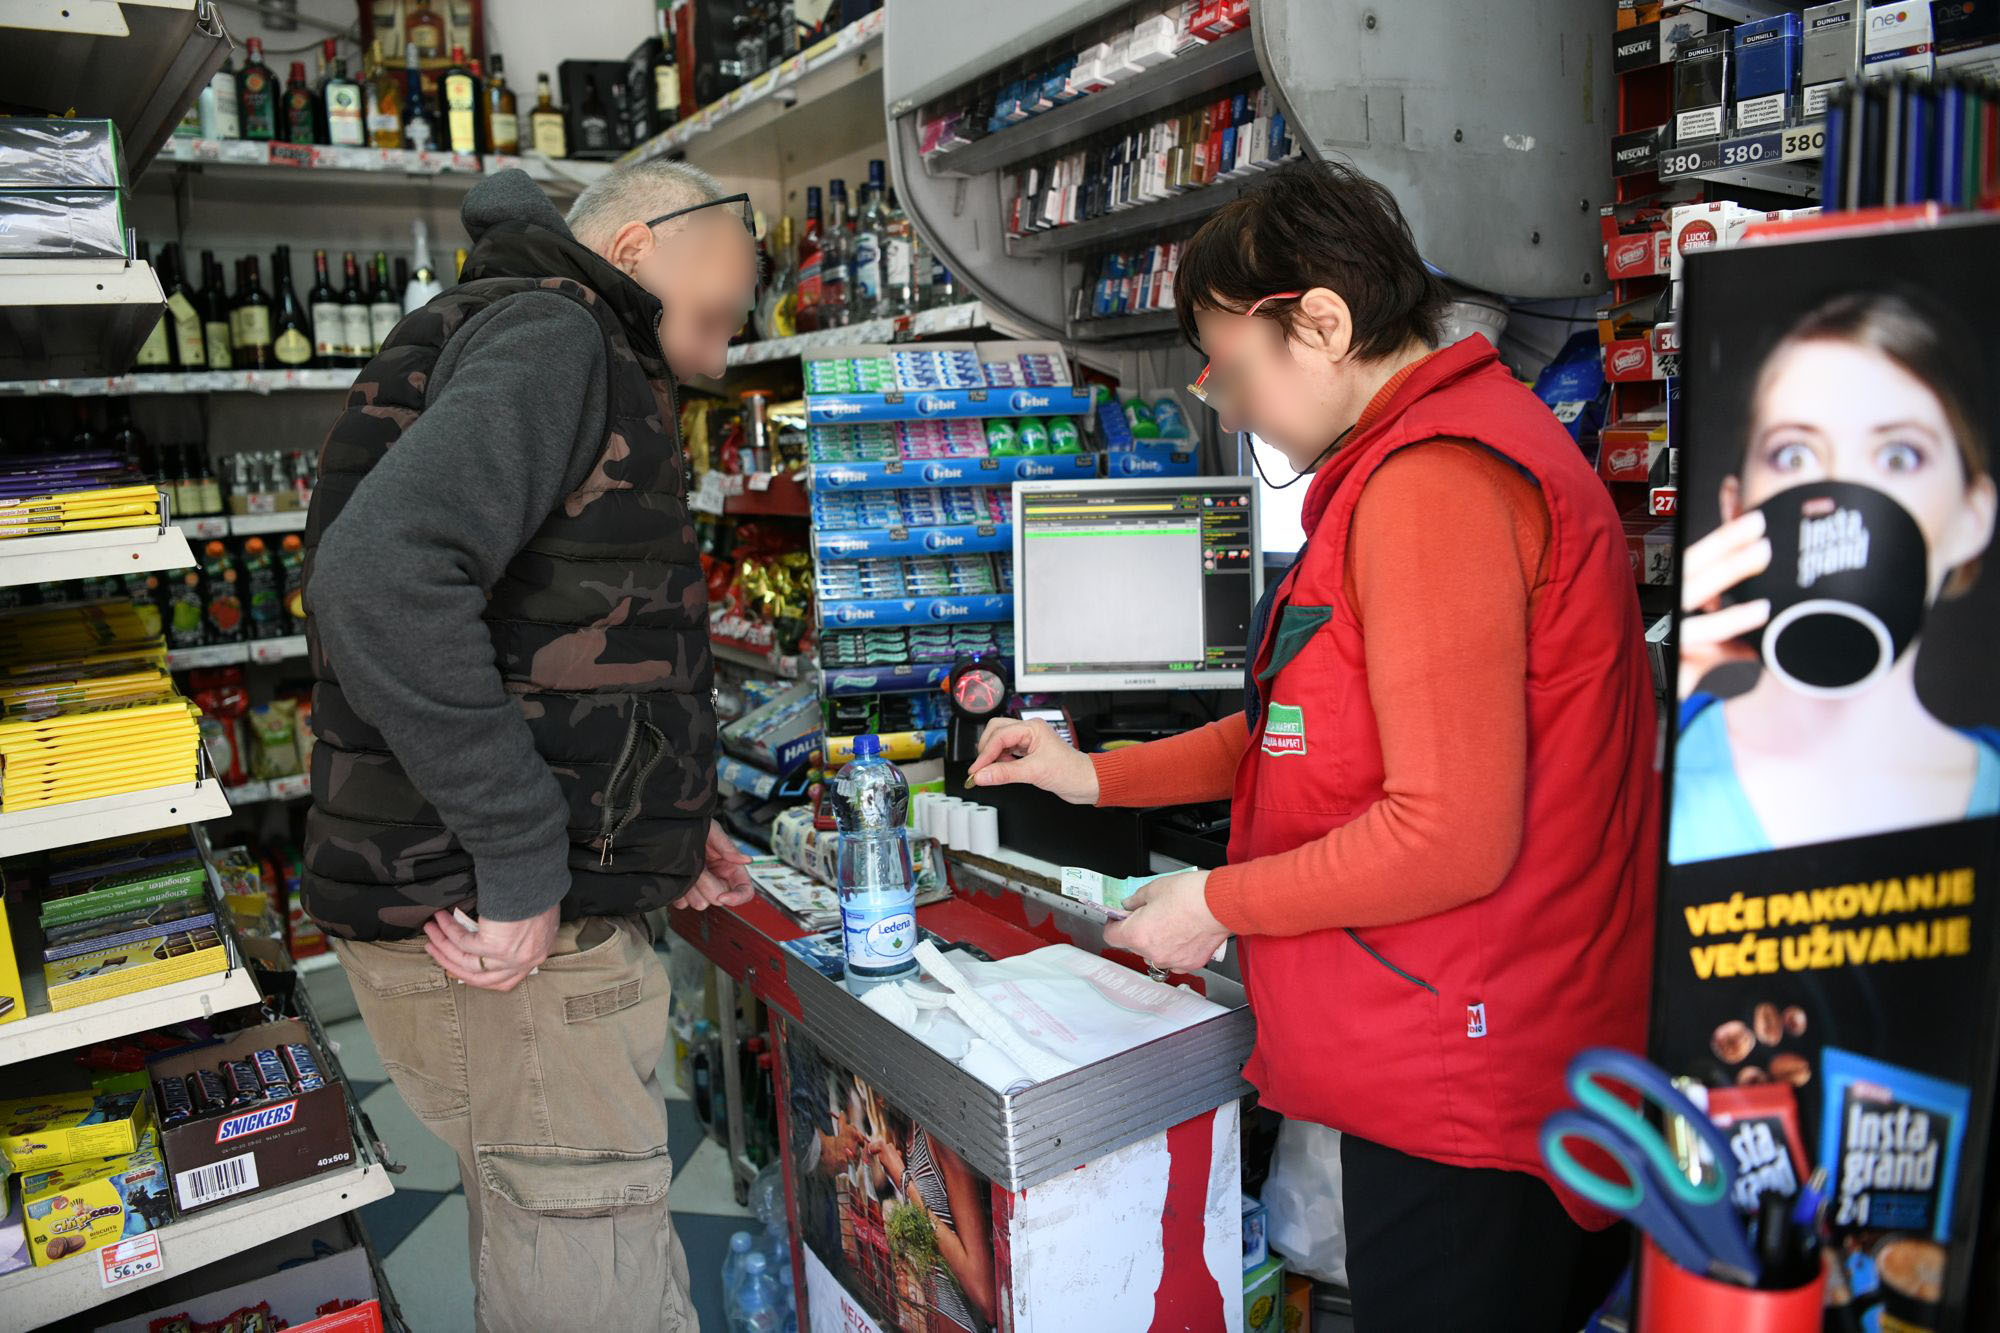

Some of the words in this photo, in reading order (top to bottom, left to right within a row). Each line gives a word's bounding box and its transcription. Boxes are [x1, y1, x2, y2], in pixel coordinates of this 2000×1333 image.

[1816, 15, 1846, 26] DUNHILL
[1746, 32, 1774, 43] DUNHILL
[1688, 47, 1714, 58] DUNHILL
[1785, 132, 1825, 153] 380
[1724, 143, 1763, 165] 380
[1764, 149, 1779, 159] DIN
[1664, 153, 1700, 174] 380
[1702, 159, 1716, 168] DIN
[1684, 240, 1710, 250] STRIKE
[1686, 232, 1710, 242] LUCKY
[918, 397, 956, 416] Orbit
[1011, 394, 1050, 411] Orbit
[924, 465, 962, 482] Orbit
[1016, 461, 1055, 478] Orbit
[1655, 496, 1679, 511] 27
[926, 533, 964, 550] Orbit
[837, 606, 876, 623] Orbit
[931, 602, 969, 619] Orbit
[149, 876, 191, 889] Schogetten
[146, 889, 188, 902] Schogetten
[1685, 893, 1765, 936] VEĆE
[1768, 867, 1975, 927] PAKOVANJE
[878, 919, 911, 935] Ledena
[1690, 933, 1779, 980] VEĆE
[1782, 916, 1971, 971] UŽIVANJE
[220, 1104, 293, 1139] SNICKERS
[1847, 1105, 1930, 1151] Insta
[317, 1152, 350, 1167] 40x50g
[1840, 1142, 1939, 1194] grand
[49, 1204, 123, 1235] Chipicao
[89, 1225, 118, 1238] BISCUITS
